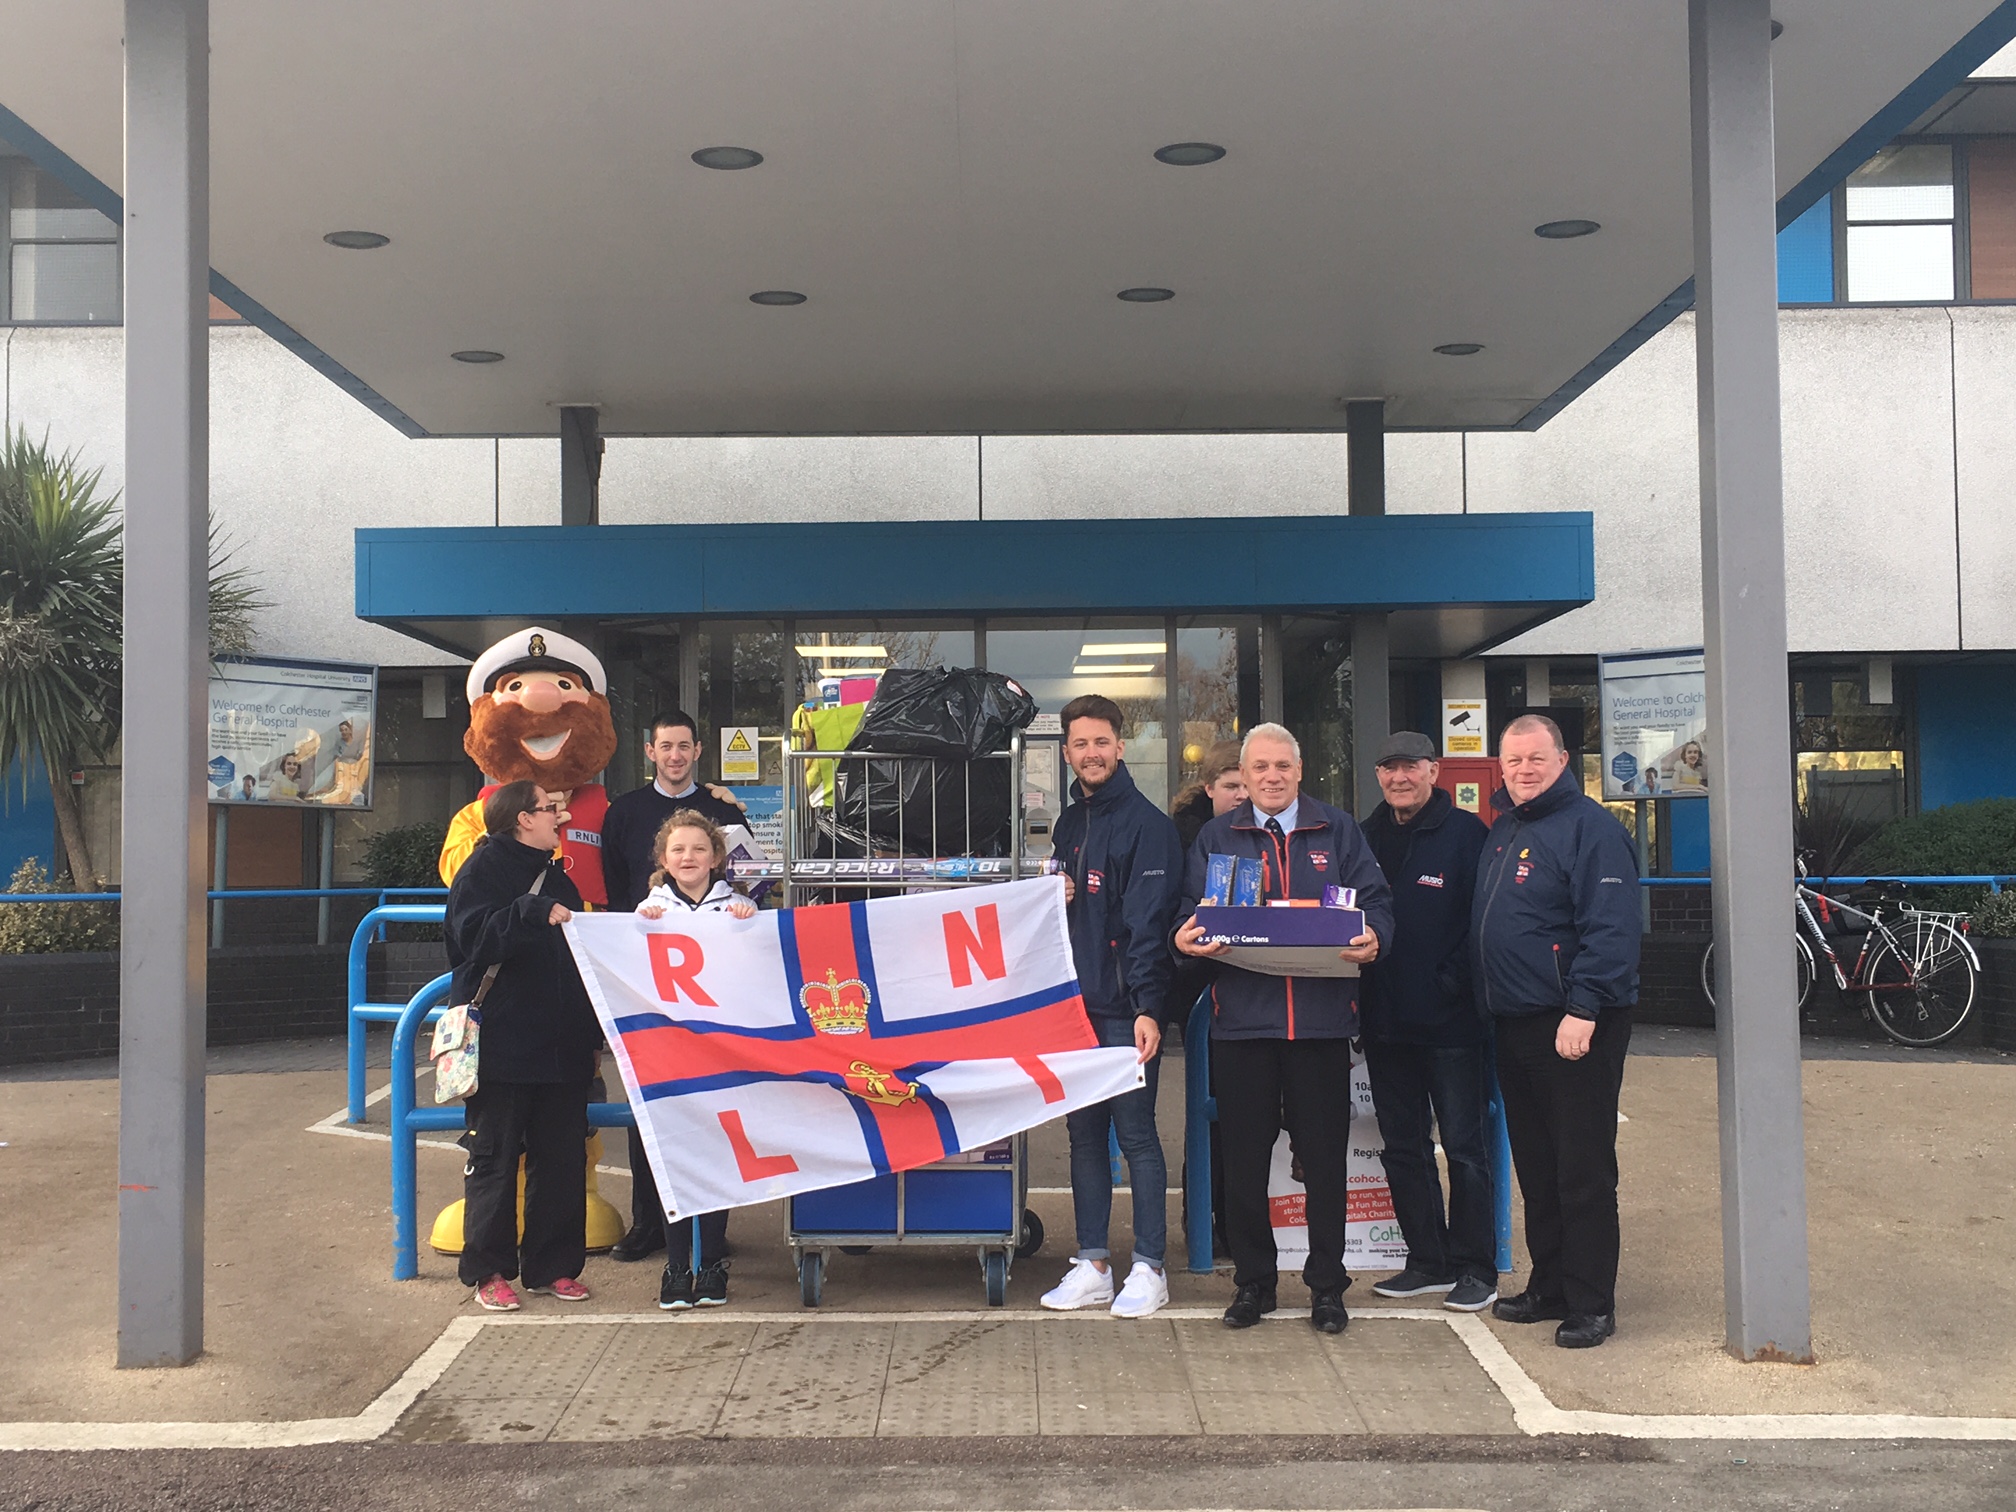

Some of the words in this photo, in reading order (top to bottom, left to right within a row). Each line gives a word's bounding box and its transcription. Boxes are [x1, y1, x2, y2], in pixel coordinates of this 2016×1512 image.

[1612, 697, 1659, 707] Welcome
[1663, 696, 1673, 705] to
[212, 699, 262, 712] Welcome
[265, 704, 276, 714] to
[280, 704, 331, 717] Colchester
[1613, 709, 1651, 720] General
[1655, 706, 1695, 719] Hospital
[213, 712, 252, 725] General
[256, 715, 297, 728] Hospital
[575, 831, 599, 844] RNLI
[836, 862, 896, 874] Race
[978, 862, 1000, 872] 10
[1418, 874, 1444, 884] MUSTO
[1212, 934, 1230, 944] 600g
[942, 903, 1007, 988] N
[646, 933, 720, 1007] R
[717, 1110, 799, 1183] L
[1275, 1198, 1290, 1206] Join
[1284, 1206, 1303, 1215] stroll
[1346, 1212, 1367, 1220] pitals
